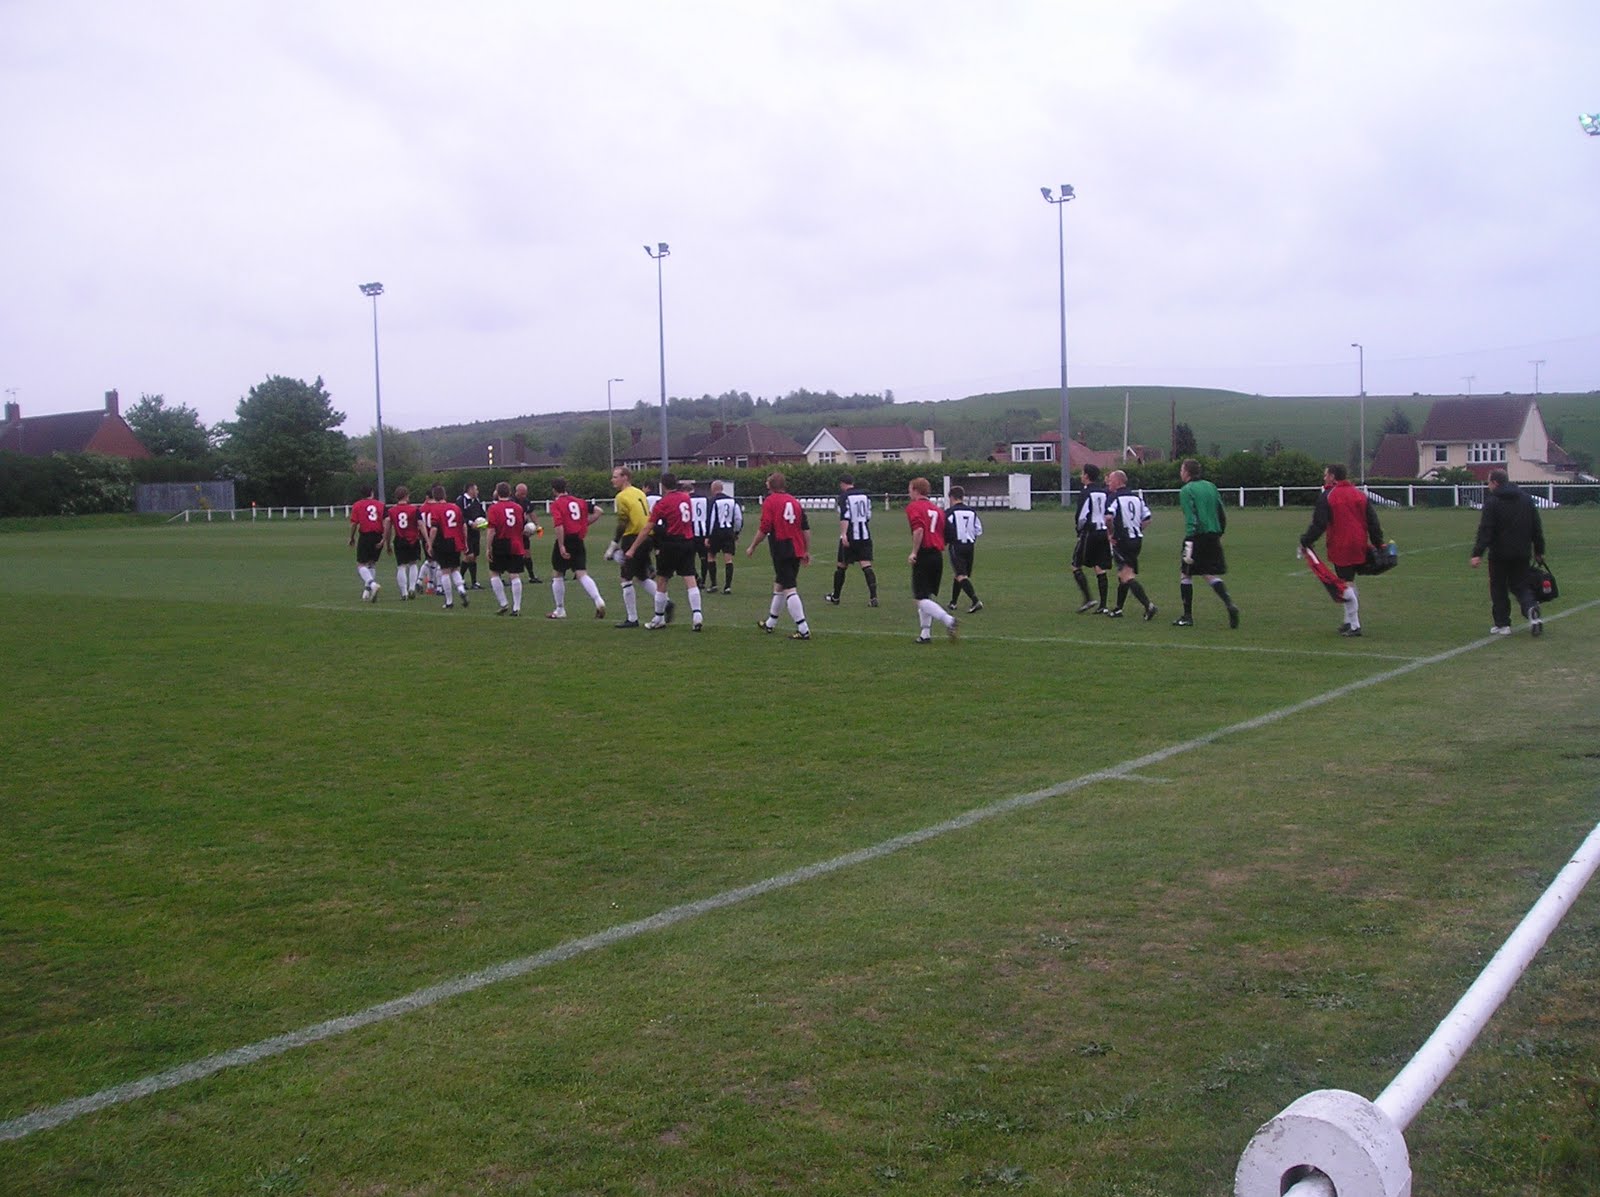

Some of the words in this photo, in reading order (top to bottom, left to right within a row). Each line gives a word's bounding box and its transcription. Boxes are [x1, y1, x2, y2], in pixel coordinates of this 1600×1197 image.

[366, 504, 378, 521] 3
[568, 501, 581, 520] 9
[638, 498, 648, 516] 1
[679, 502, 691, 523] 6
[696, 502, 702, 518] 6
[723, 503, 730, 519] 3
[783, 501, 796, 524] 4
[854, 500, 866, 518] 10
[1128, 500, 1136, 521] 9
[397, 512, 408, 529] 8
[445, 509, 457, 528] 2
[504, 508, 516, 527] 5
[927, 509, 938, 534] 7
[962, 516, 970, 530] 7
